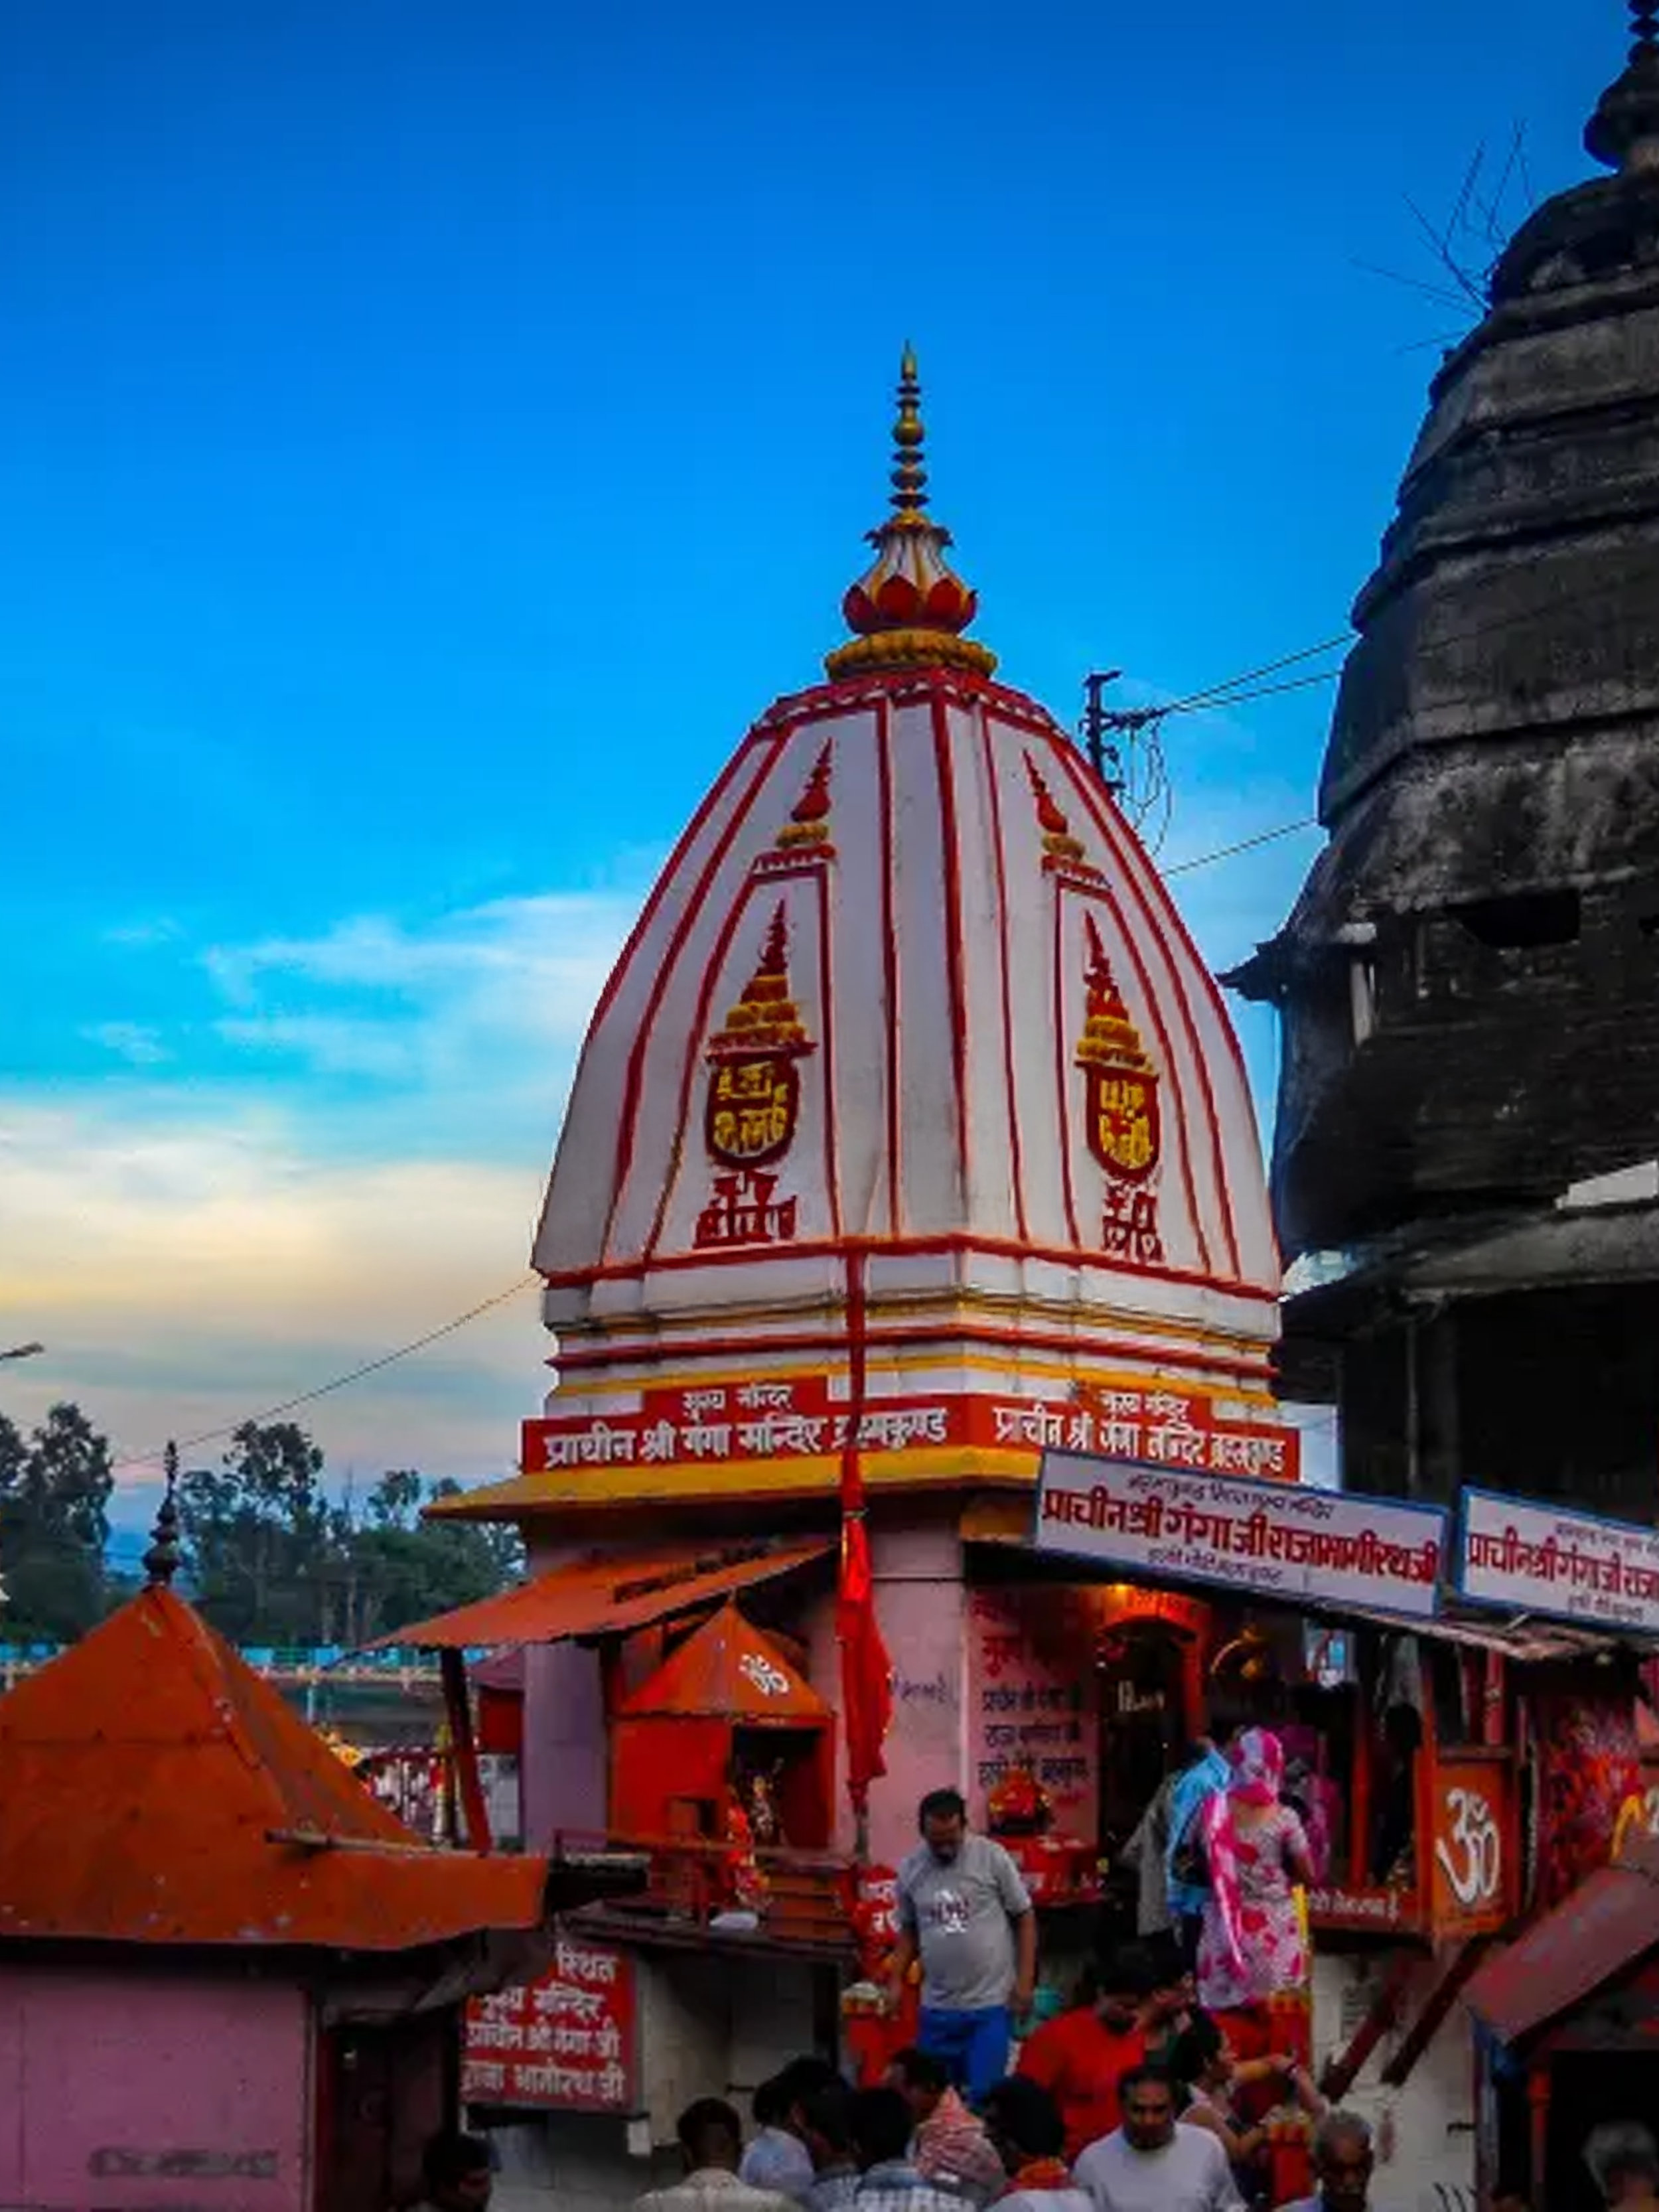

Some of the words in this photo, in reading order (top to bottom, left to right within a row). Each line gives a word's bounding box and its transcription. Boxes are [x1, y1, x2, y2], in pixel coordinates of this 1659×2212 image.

[543, 1418, 637, 1469] प्राचीन
[640, 1420, 676, 1461] श्री
[993, 1402, 1064, 1447] प्राचीन
[1067, 1408, 1094, 1451] श्री
[1043, 1487, 1126, 1532] प्राचीन
[1128, 1493, 1163, 1539] श्री
[1164, 1502, 1232, 1550] गंगा
[1469, 1525, 1530, 1574] प्राचीन
